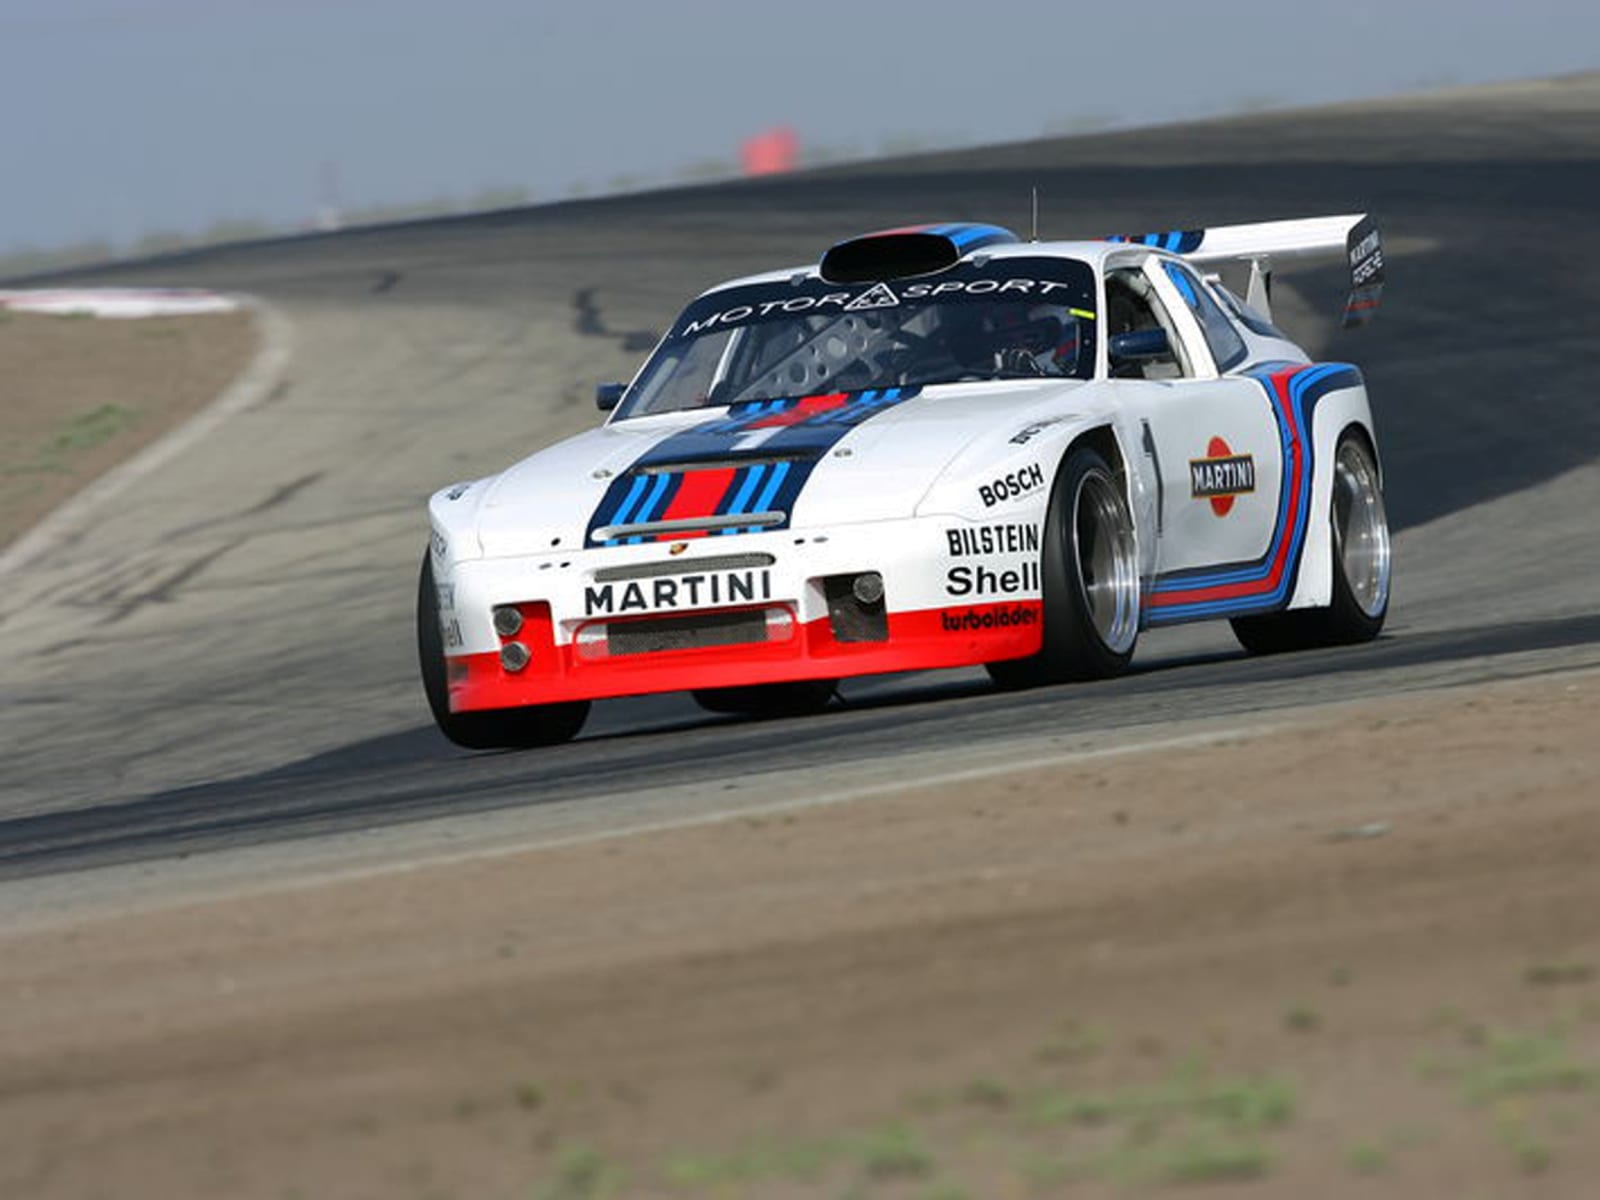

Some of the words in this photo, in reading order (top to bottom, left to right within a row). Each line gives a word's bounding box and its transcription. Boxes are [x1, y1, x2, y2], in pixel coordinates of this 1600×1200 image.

[682, 292, 851, 336] MOTOR
[902, 279, 1068, 298] SPORT
[979, 463, 1044, 508] BOSCH
[1192, 461, 1254, 491] MARTINI
[946, 524, 1039, 557] BILSTEIN
[585, 570, 770, 615] MARTINI
[946, 562, 1039, 596] Shell
